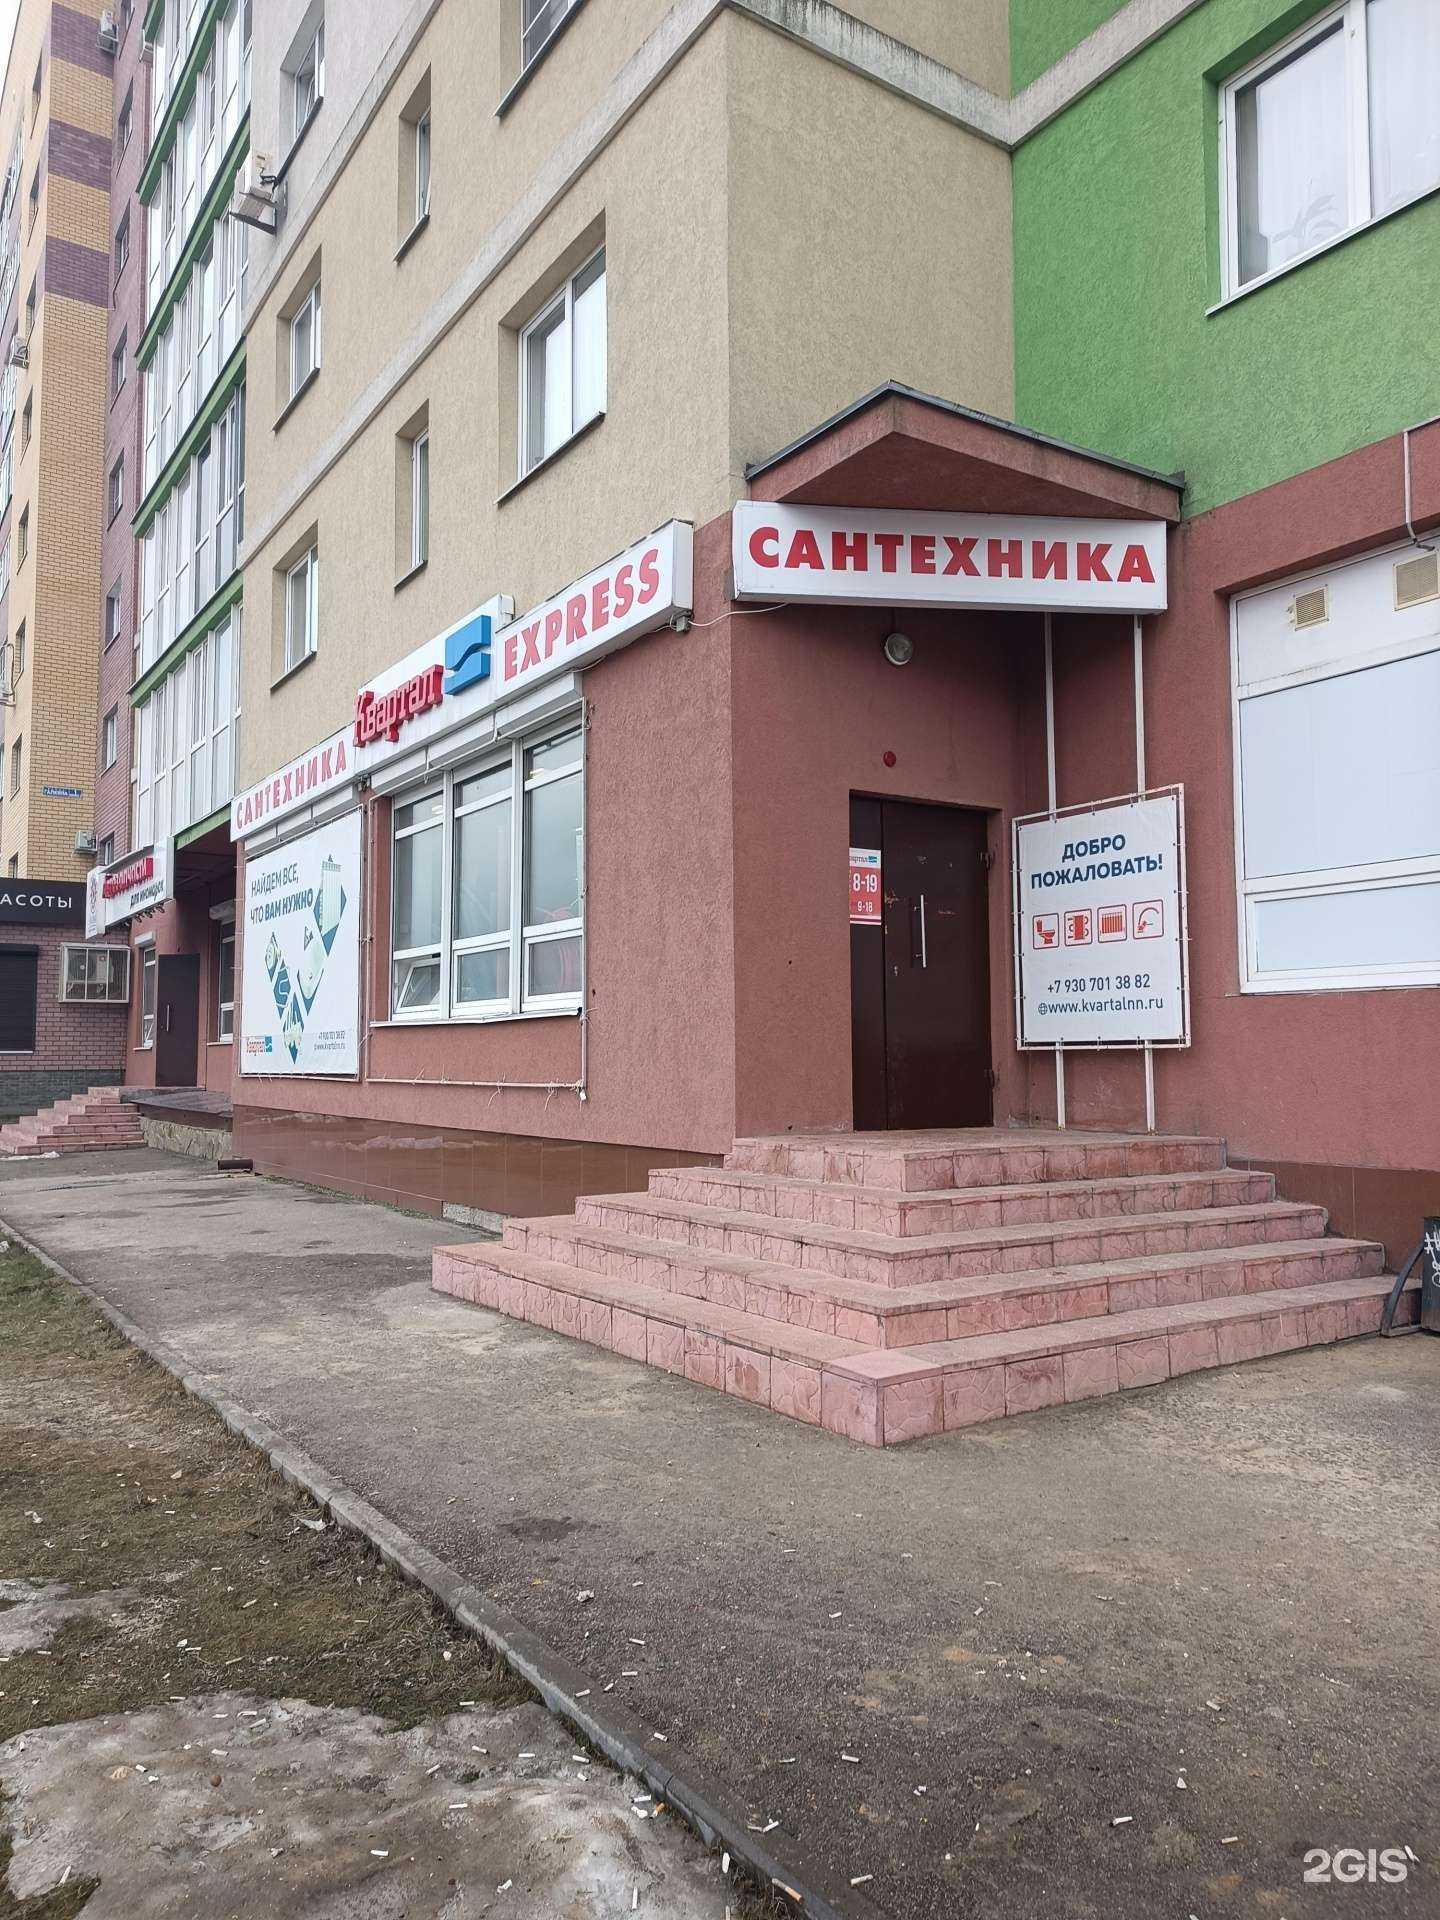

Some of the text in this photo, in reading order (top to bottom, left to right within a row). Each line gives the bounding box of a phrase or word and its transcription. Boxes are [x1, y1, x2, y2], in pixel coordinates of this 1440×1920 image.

[749, 527, 1156, 583] САНТЕХНИКА
[236, 548, 660, 831] САНТЕХНИКА Квартал EXPRESS
[1062, 834, 1126, 863] ДОБРО
[251, 869, 282, 897] НАЙДЕМ
[853, 873, 877, 893] 8-19
[1031, 853, 1163, 890] ПОЖАЛОВАТЬ!
[250, 888, 314, 925] ЧТО ВАМ НУЖНО
[1047, 973, 1151, 993] +7 930 701 38 82
[1049, 995, 1163, 1014] www.kvartalnn.ru
